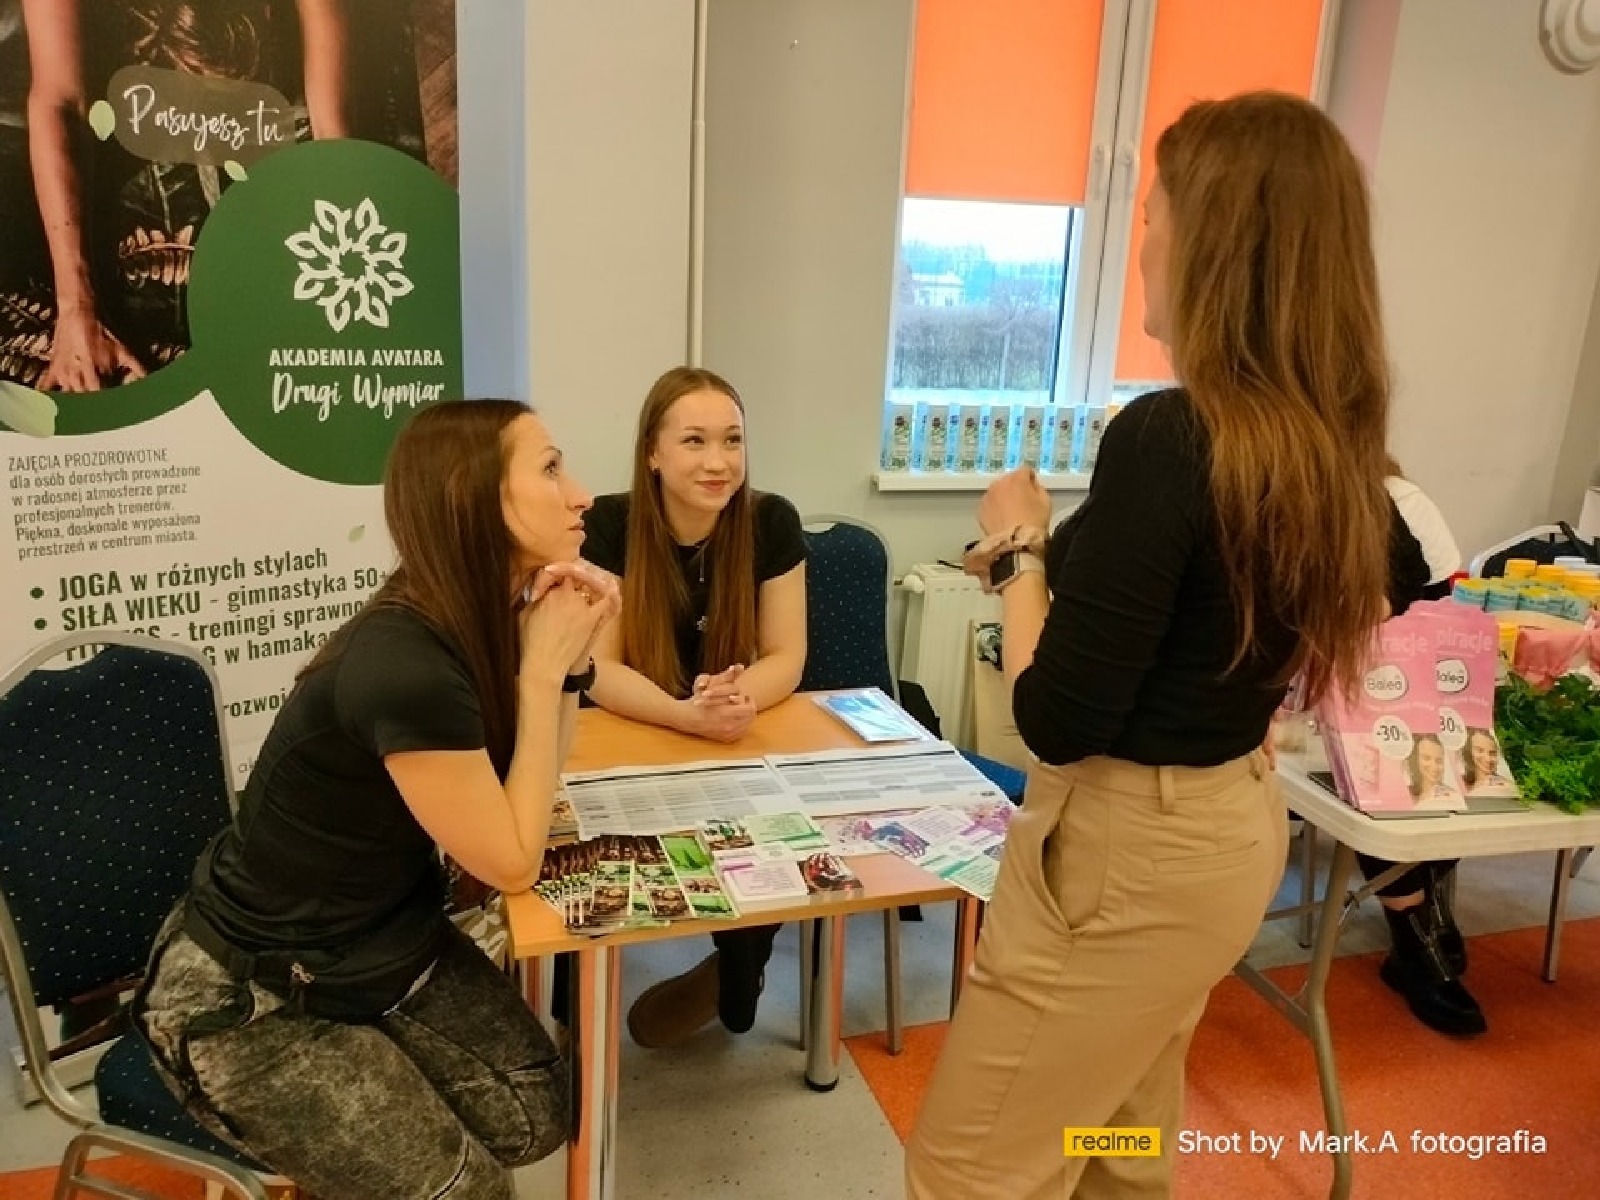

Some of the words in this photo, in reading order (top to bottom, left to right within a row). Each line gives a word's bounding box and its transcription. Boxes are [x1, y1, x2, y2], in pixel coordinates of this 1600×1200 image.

[122, 84, 250, 152] Pasujesz
[269, 347, 367, 366] AKADEMIA
[371, 347, 445, 366] AVATARA
[272, 372, 342, 422] Drugi
[353, 372, 445, 420] Wymiar
[8, 455, 61, 473] ZAJĘCIA
[65, 448, 167, 468] PROZDROWOTNE
[9, 475, 30, 489] dla
[35, 473, 65, 487] osób
[69, 468, 128, 486] dorosłych
[132, 465, 200, 483] prowadzone
[12, 495, 23, 506] w
[27, 490, 83, 506] radosnej
[86, 484, 152, 501] atmosferze
[157, 483, 187, 500] przez
[14, 503, 114, 526] profesjonalnych
[67, 518, 128, 537] doskonale
[132, 513, 200, 531] wyposażona
[18, 539, 85, 561] przestrzeń
[89, 539, 98, 551] w
[101, 533, 152, 549] centrum
[59, 570, 122, 602] JOGA
[130, 573, 148, 591] w
[156, 556, 246, 588] różnych
[254, 547, 328, 578] stylach
[61, 601, 118, 631] SIŁA
[125, 590, 200, 622] WIEKU
[227, 573, 347, 613] gimnastyka
[189, 608, 276, 641] treningi
[283, 600, 365, 631] sprawno
[224, 646, 240, 664] w
[247, 630, 329, 660] hamaka
